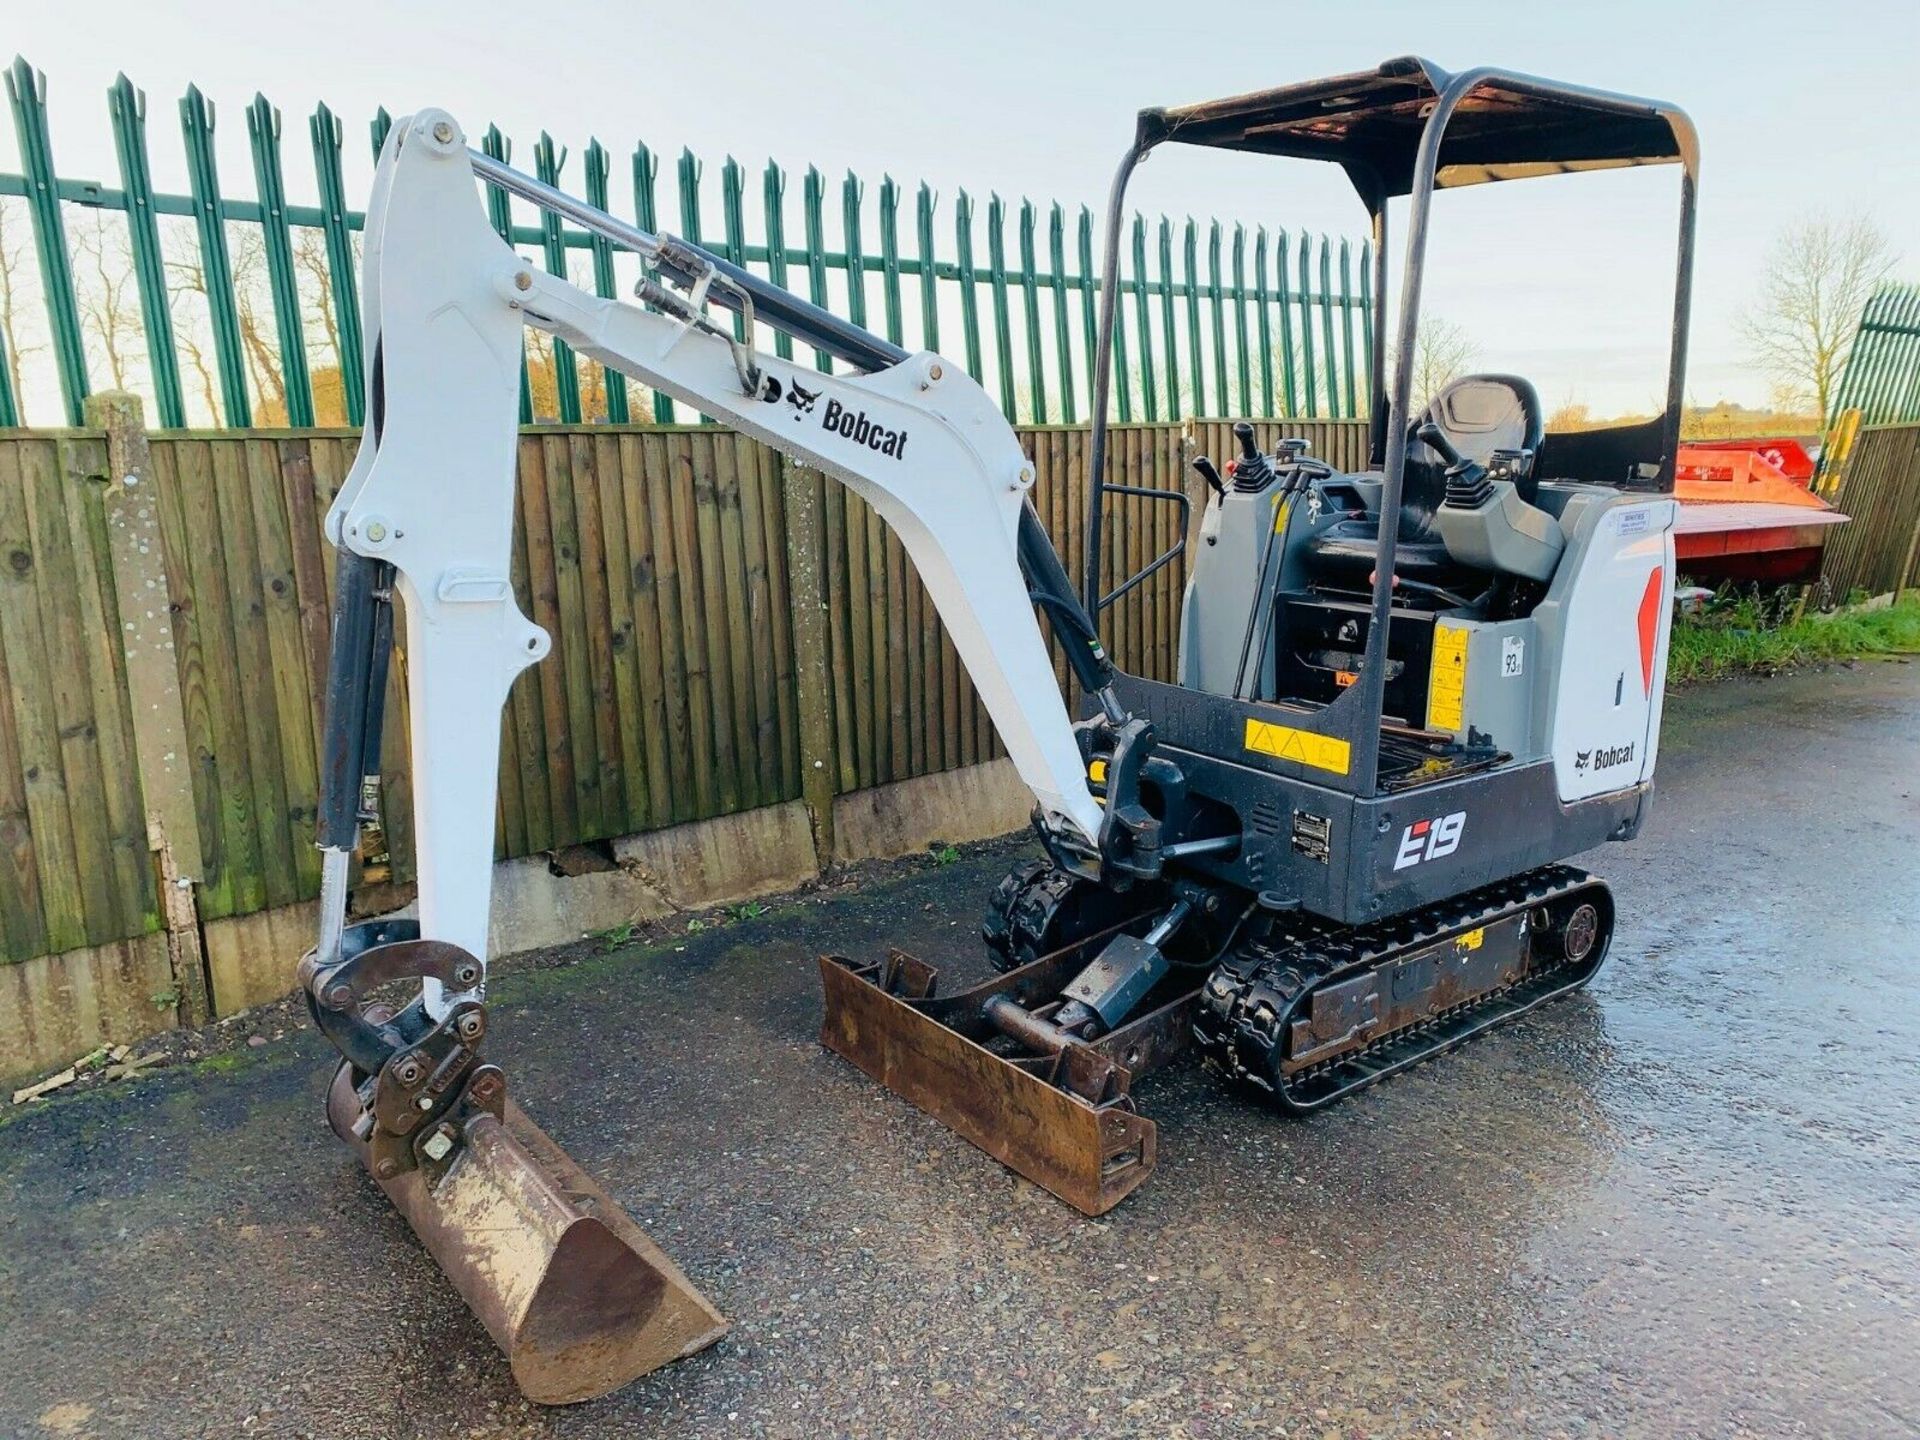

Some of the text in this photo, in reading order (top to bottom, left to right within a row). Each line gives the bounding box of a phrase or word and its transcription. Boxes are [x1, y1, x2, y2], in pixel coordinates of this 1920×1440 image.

[822, 399, 908, 460] Bobcat
[1505, 653, 1517, 673] 93
[1594, 741, 1634, 771] Bobcat
[1393, 811, 1467, 871] E19
